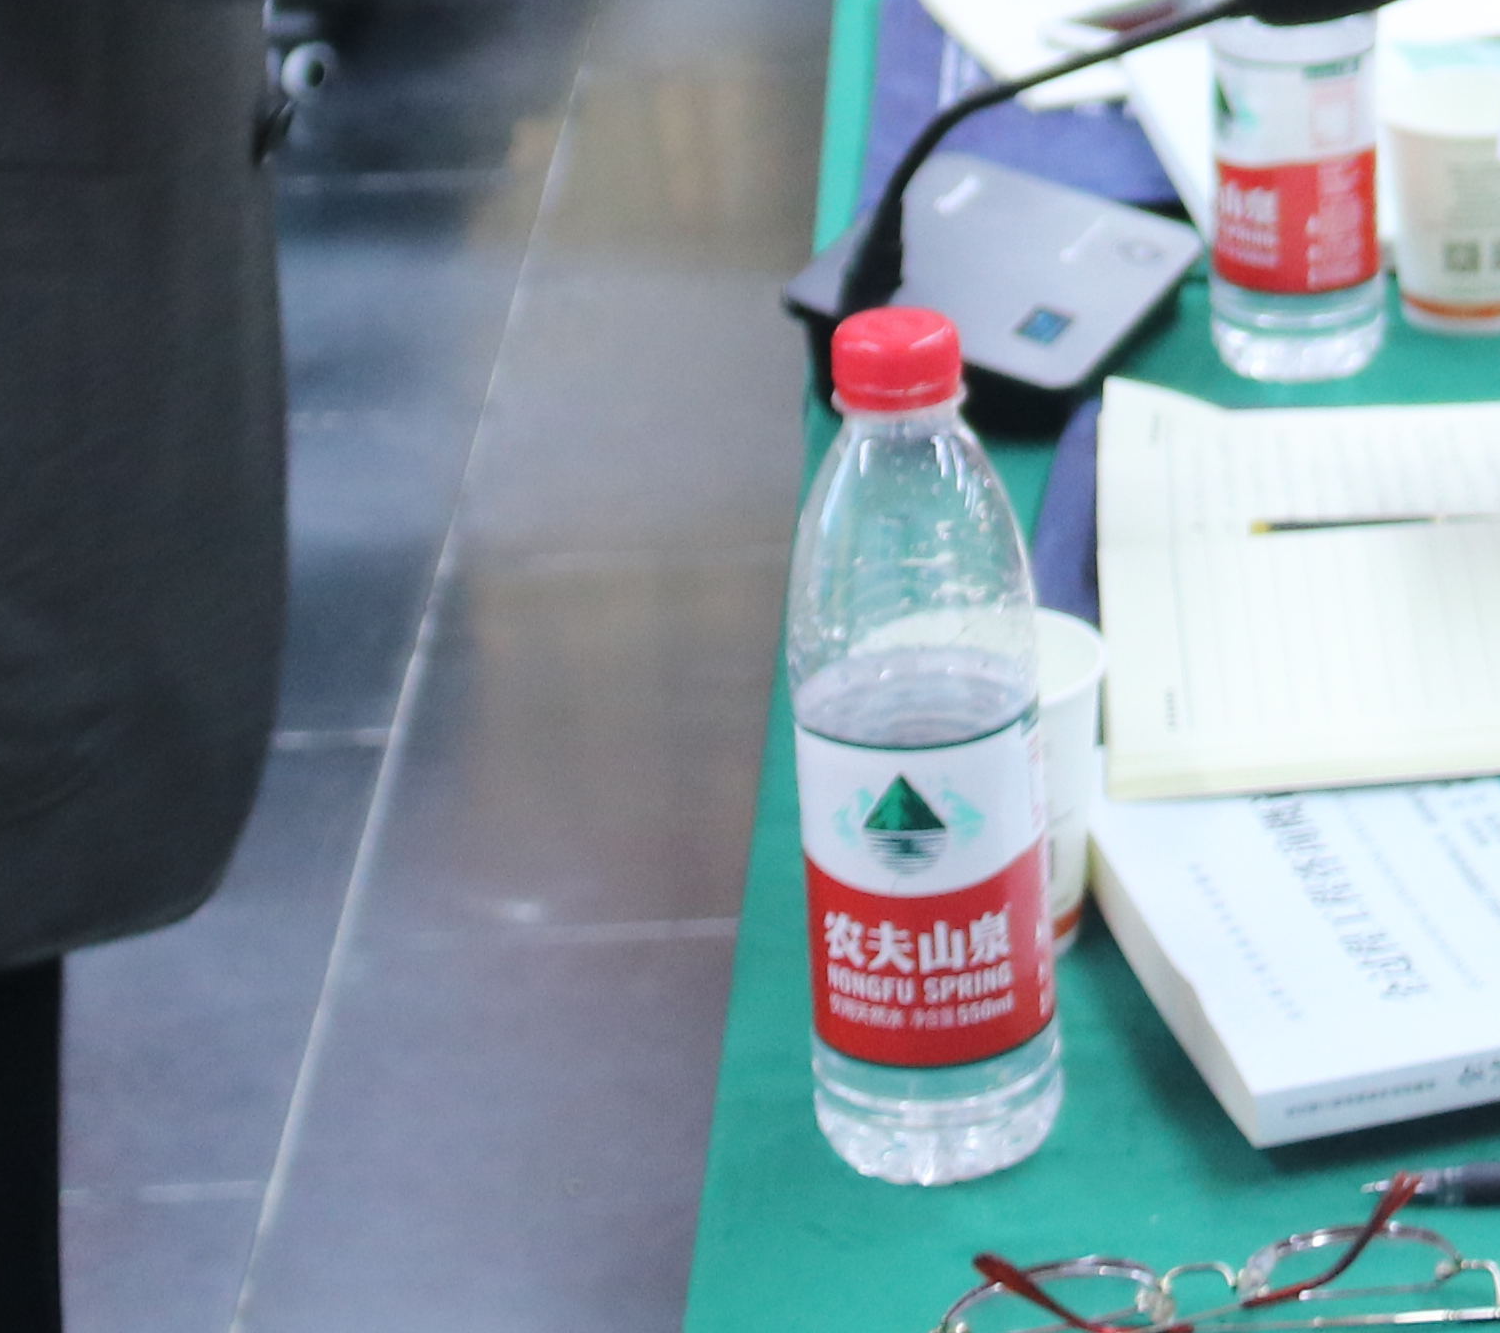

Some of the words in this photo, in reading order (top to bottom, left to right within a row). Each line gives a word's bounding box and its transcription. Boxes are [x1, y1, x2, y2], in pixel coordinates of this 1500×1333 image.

[823, 911, 1011, 975] 农夫山泉
[826, 961, 915, 1006] NONGFU
[923, 959, 1014, 1005] SPRING
